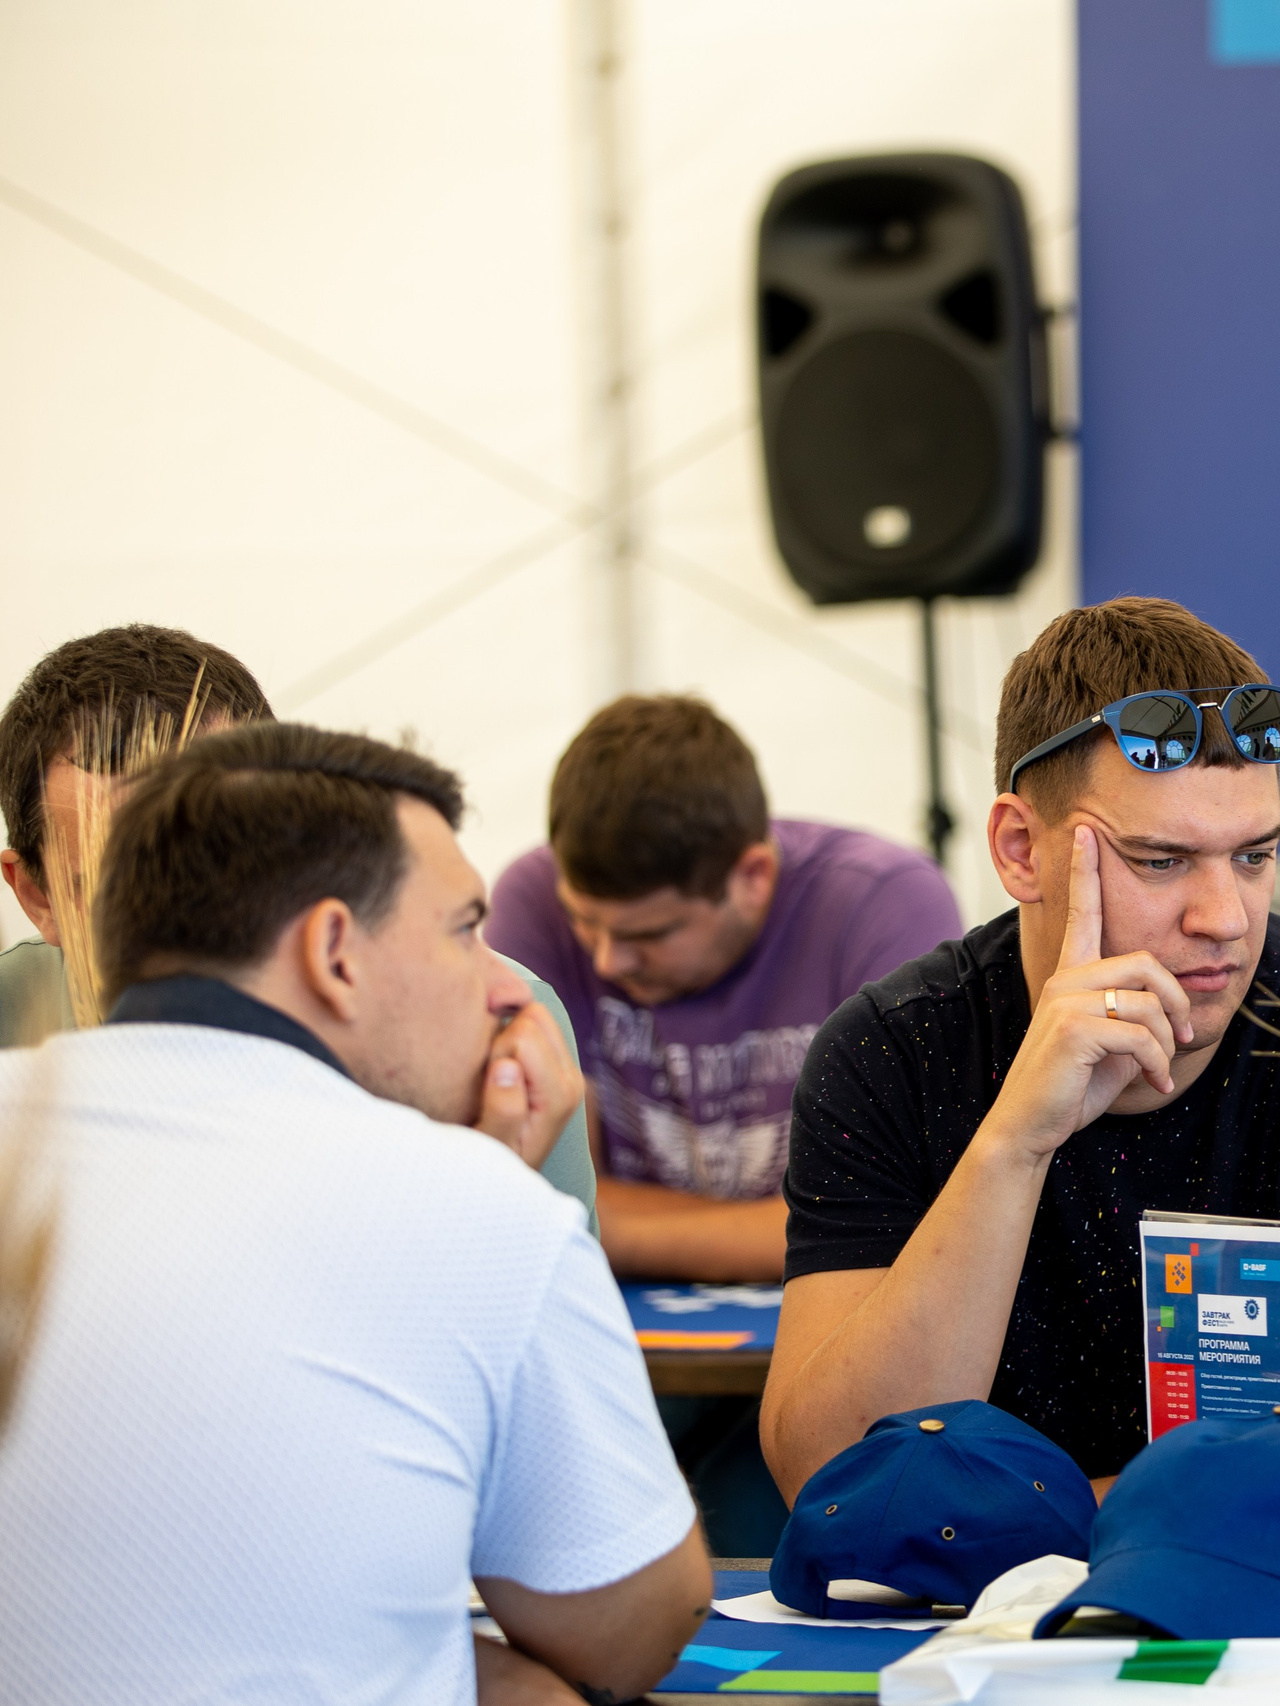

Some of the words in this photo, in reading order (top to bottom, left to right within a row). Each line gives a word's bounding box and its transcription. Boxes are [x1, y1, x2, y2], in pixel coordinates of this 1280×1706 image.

[1202, 1311, 1231, 1320] ЗАВТРАК
[1198, 1338, 1251, 1352] ПРОГРАММА
[1199, 1351, 1262, 1365] МЕРОПРИЯТИЯ
